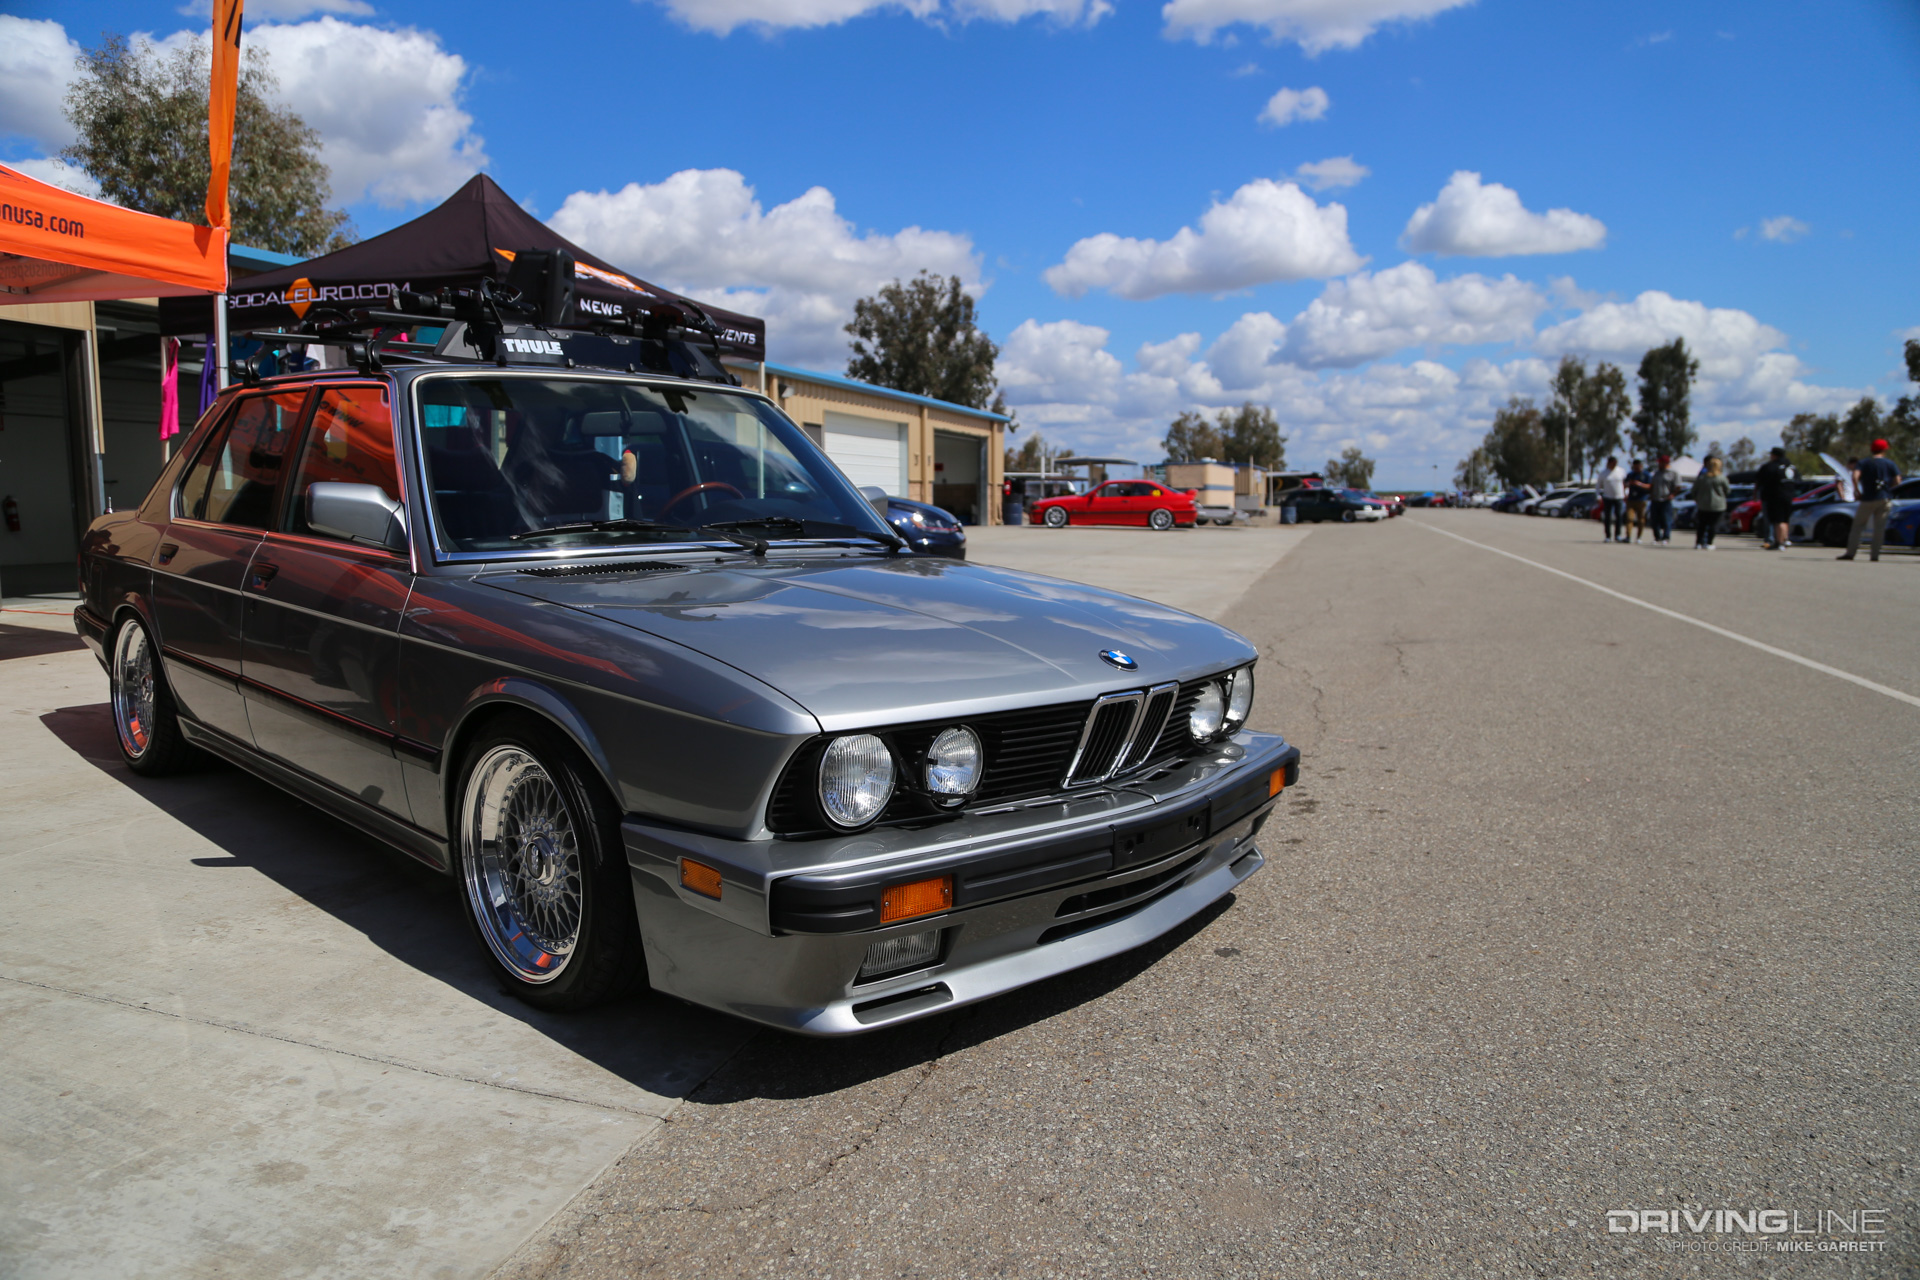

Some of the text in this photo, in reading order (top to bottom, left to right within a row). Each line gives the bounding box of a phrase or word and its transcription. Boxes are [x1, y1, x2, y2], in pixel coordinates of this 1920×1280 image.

[0, 203, 84, 239] nusa.com
[580, 298, 623, 316] NEWS
[502, 338, 563, 355] THULE
